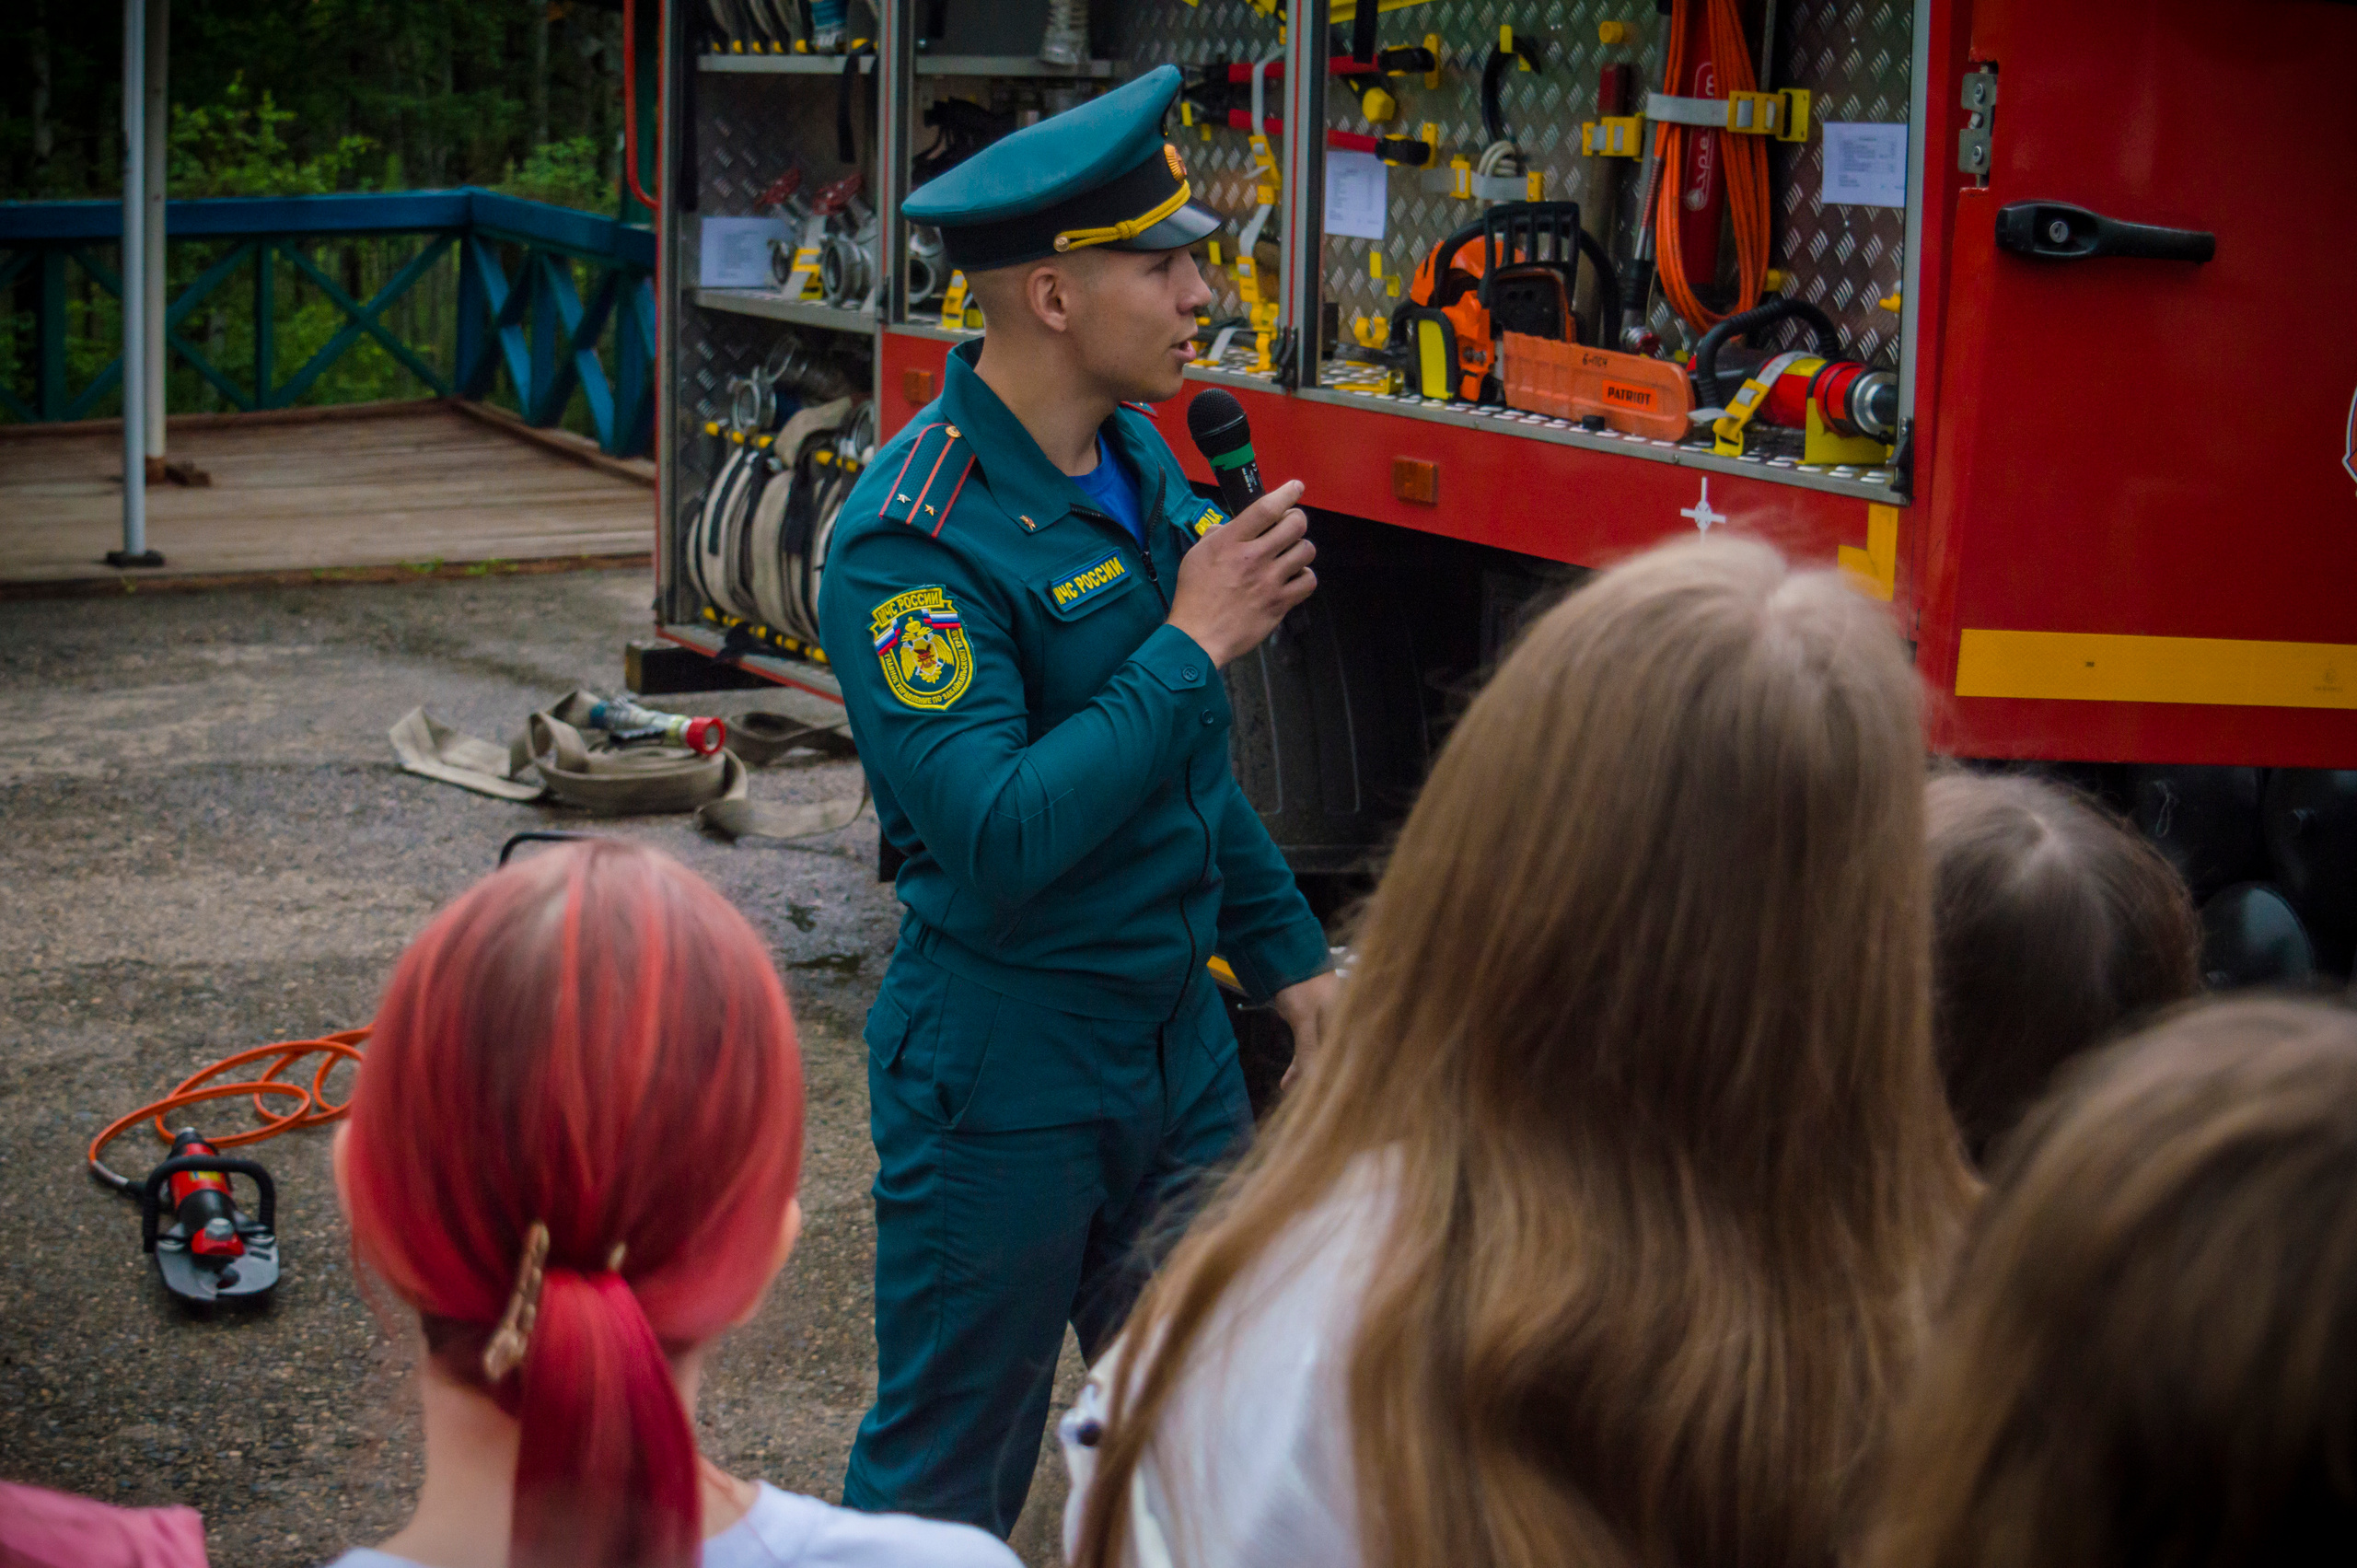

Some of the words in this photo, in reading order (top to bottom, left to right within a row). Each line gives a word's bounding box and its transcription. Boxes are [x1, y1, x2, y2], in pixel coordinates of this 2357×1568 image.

[1608, 387, 1651, 405] PATRIOT
[1052, 582, 1078, 605] МЧС
[1074, 557, 1125, 594] РОССИИ
[877, 602, 898, 623] МЧС
[898, 592, 939, 612] РОССИИ
[951, 630, 963, 648] КРАЮ
[884, 654, 900, 685] ГЛАВНОЕ
[944, 649, 968, 700] ЗАБАЙКАЛЬСКОМУ
[896, 683, 932, 704] УПРАВЛЕНИЕ
